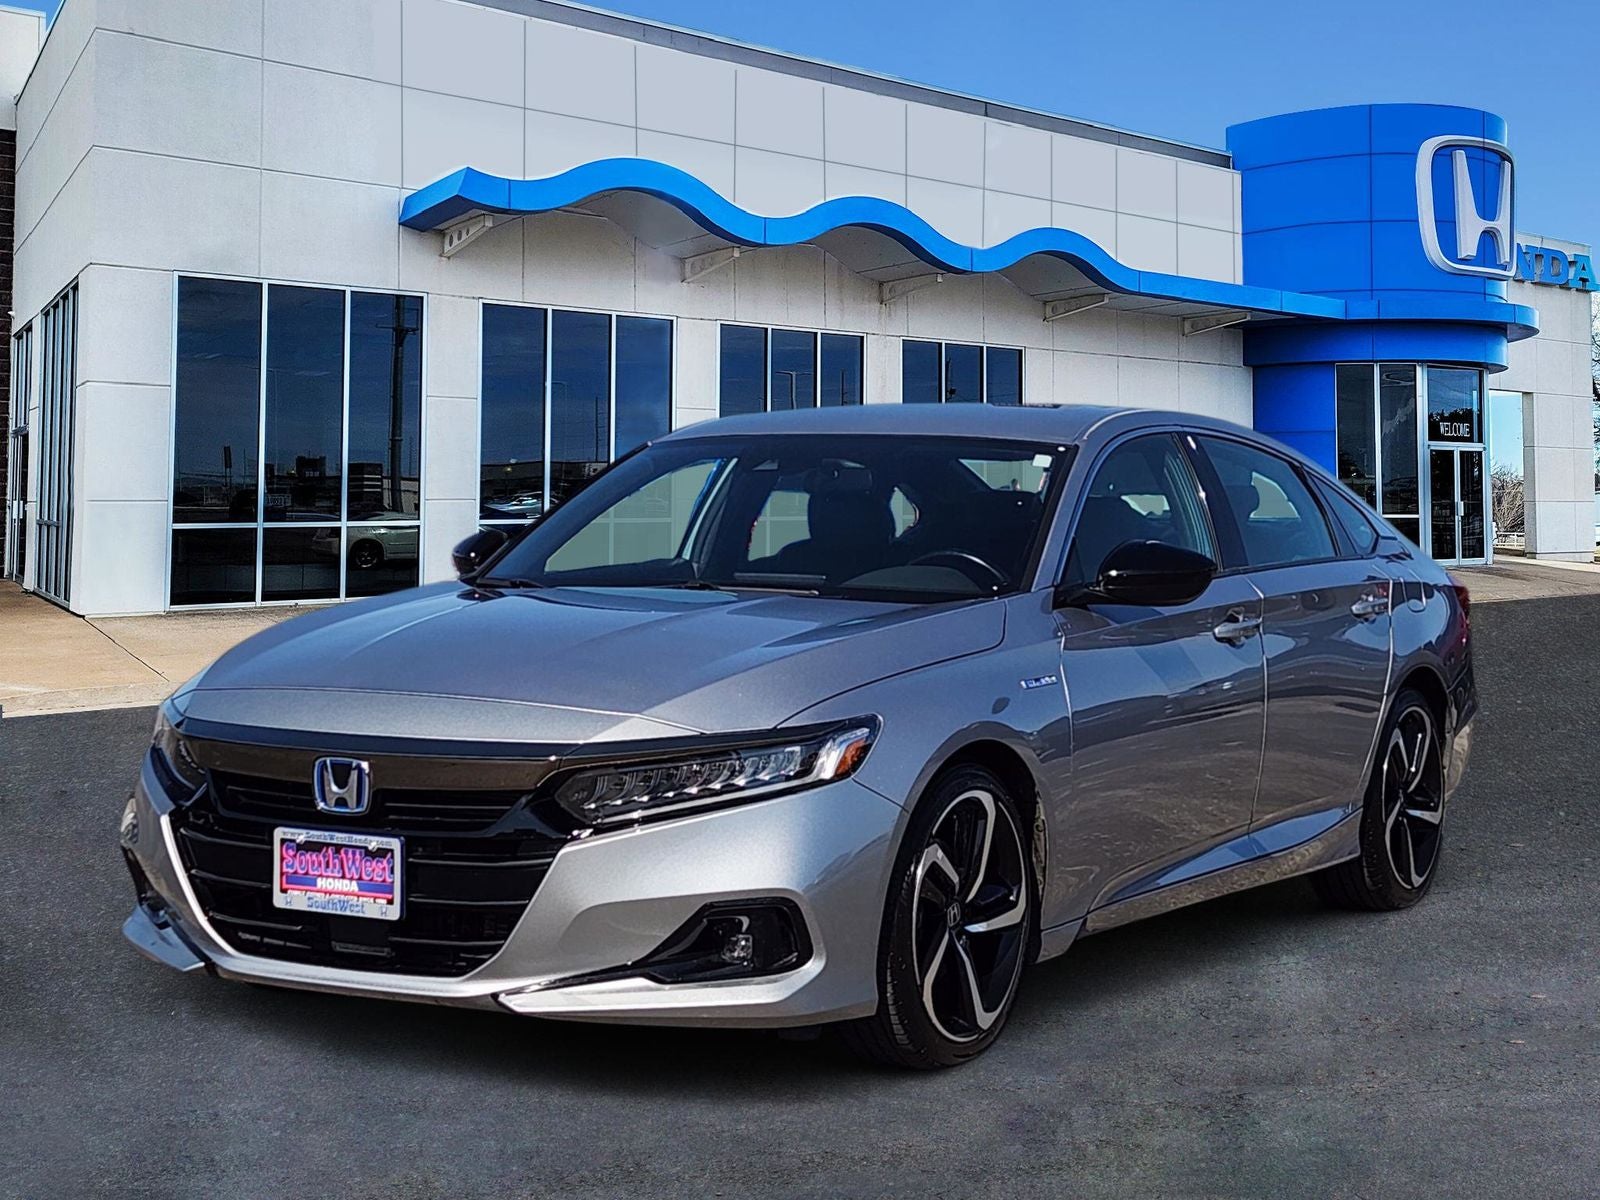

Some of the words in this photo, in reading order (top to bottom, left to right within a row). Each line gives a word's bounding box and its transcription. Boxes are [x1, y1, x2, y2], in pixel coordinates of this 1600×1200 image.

[1440, 422, 1470, 437] WELCOME
[281, 830, 393, 847] wwwSouthWestHondacom
[316, 877, 359, 892] HONDA
